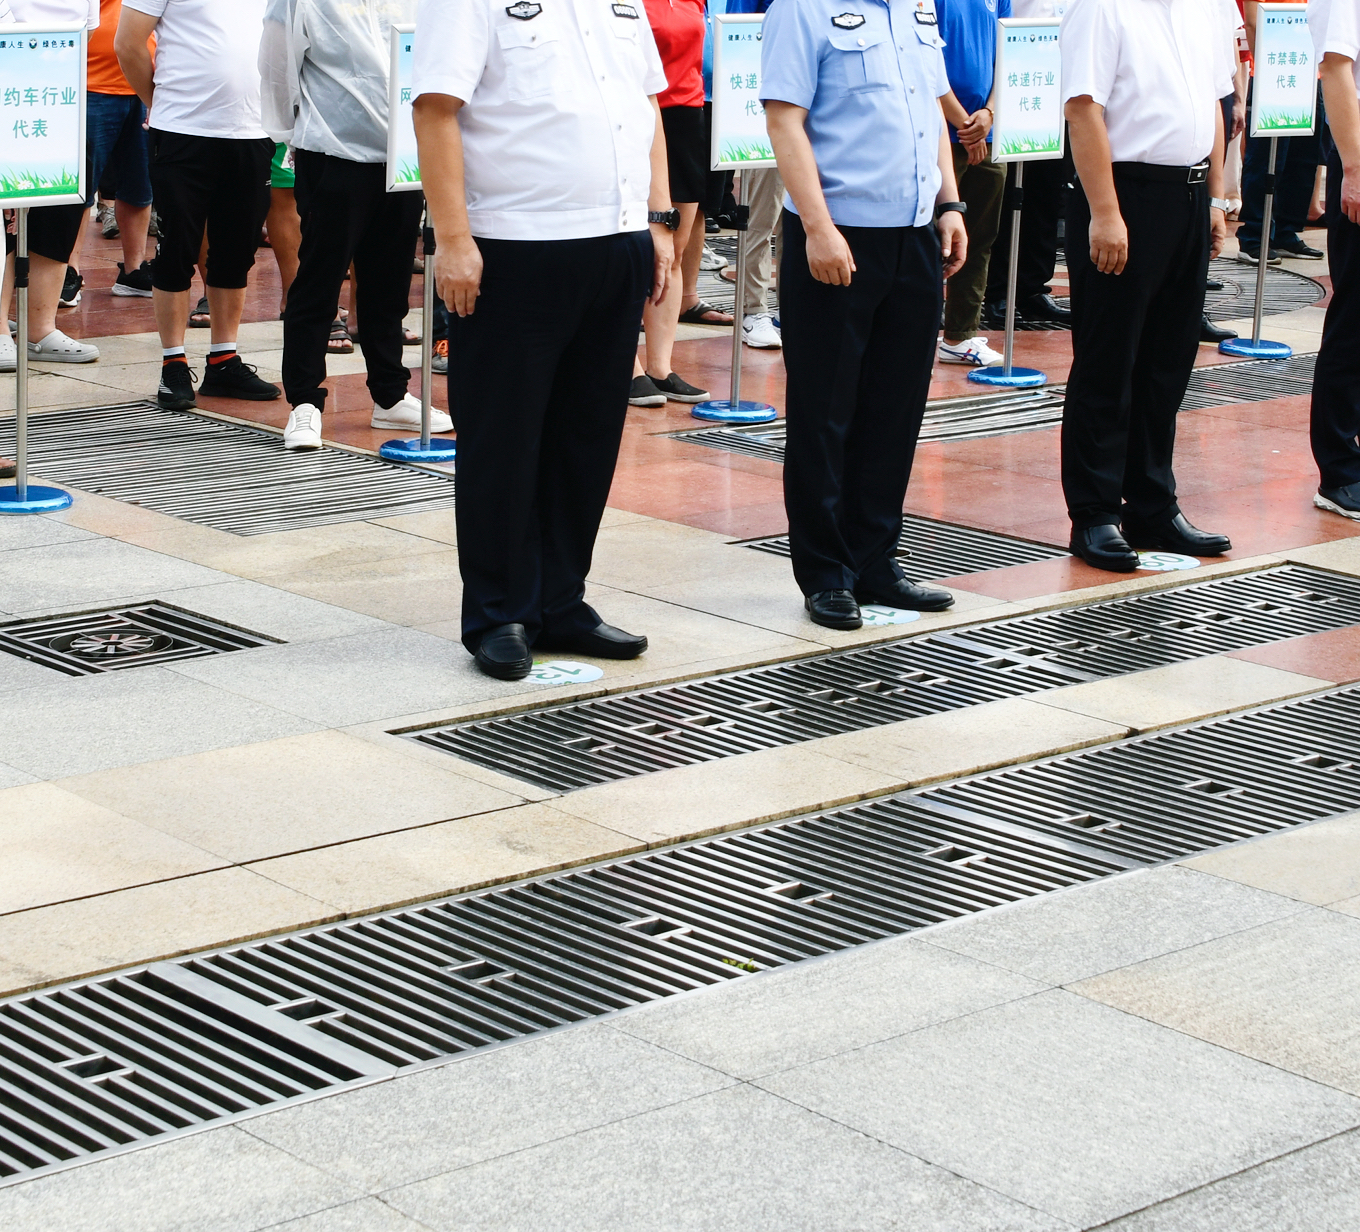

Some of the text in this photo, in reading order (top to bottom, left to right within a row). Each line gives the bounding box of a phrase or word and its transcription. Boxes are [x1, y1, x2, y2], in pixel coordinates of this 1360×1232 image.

[42, 39, 75, 49] 绿色无毒
[1267, 51, 1308, 66] 市禁毒办
[730, 73, 763, 90] 快递
[1007, 71, 1055, 88] 快递行业
[1276, 74, 1297, 89] 代表
[1019, 96, 1042, 112] 代表
[12, 119, 49, 139] 代表
